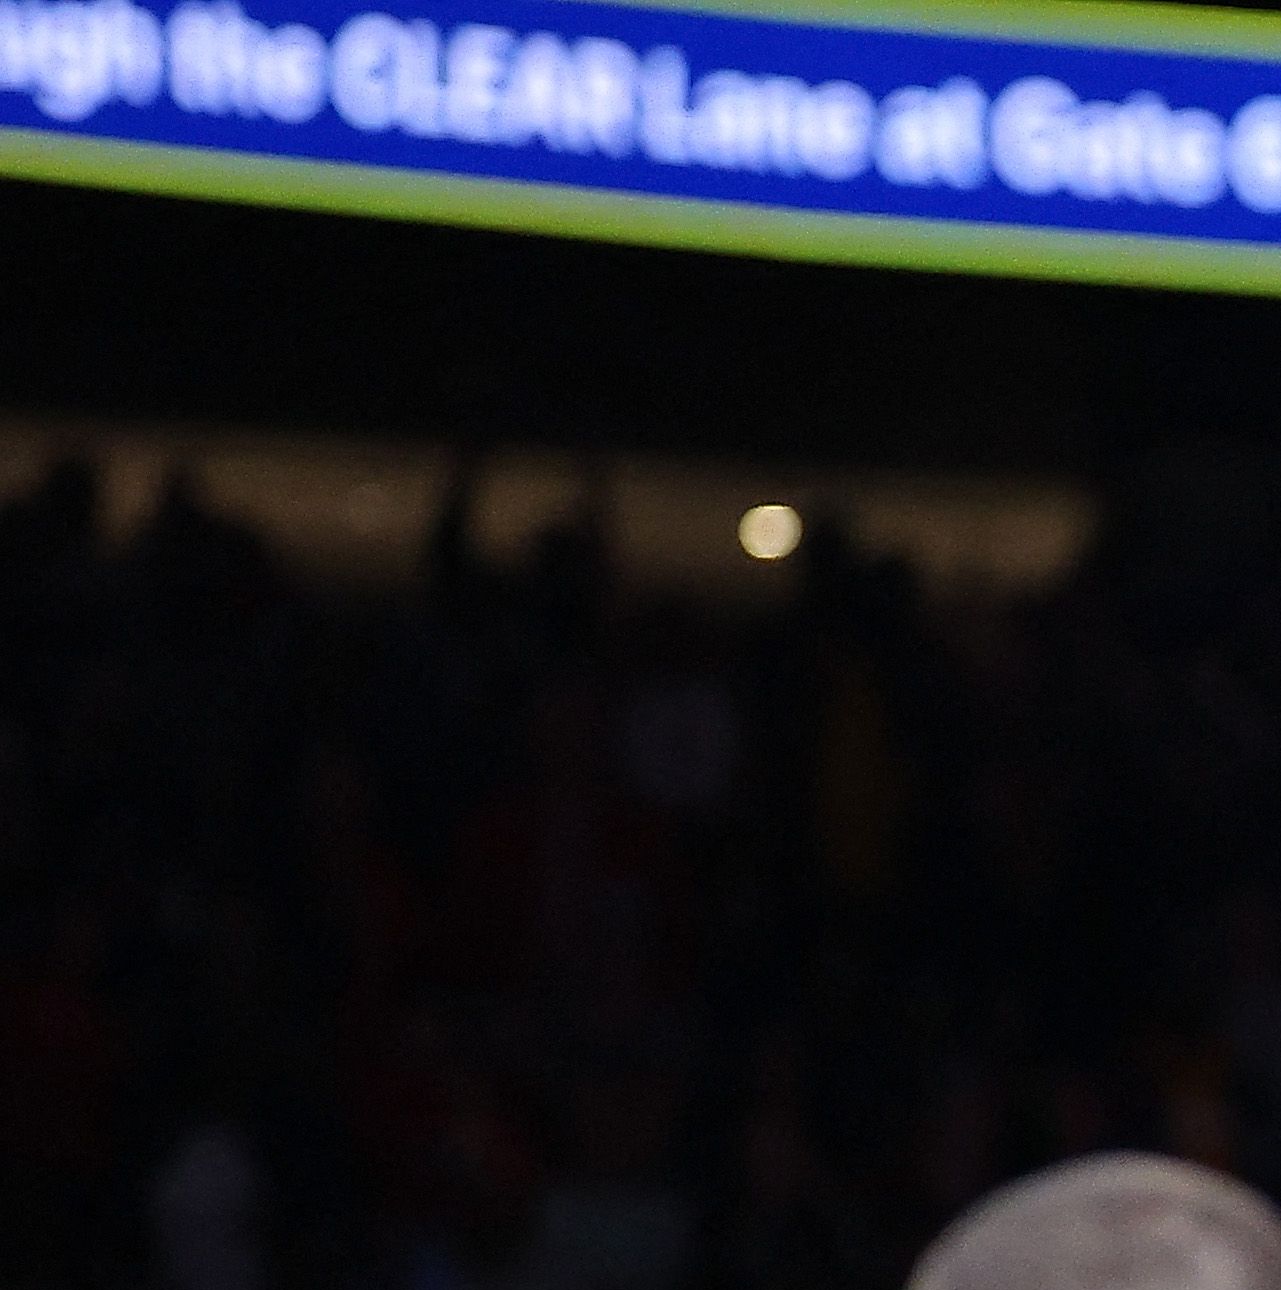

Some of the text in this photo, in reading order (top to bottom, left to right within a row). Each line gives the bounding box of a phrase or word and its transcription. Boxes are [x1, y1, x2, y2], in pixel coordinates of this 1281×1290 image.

[166, 1, 328, 122] the
[330, 13, 640, 158] CLEAR
[640, 45, 877, 180] Lane
[877, 77, 990, 189] at
[990, 76, 1226, 206] Gate
